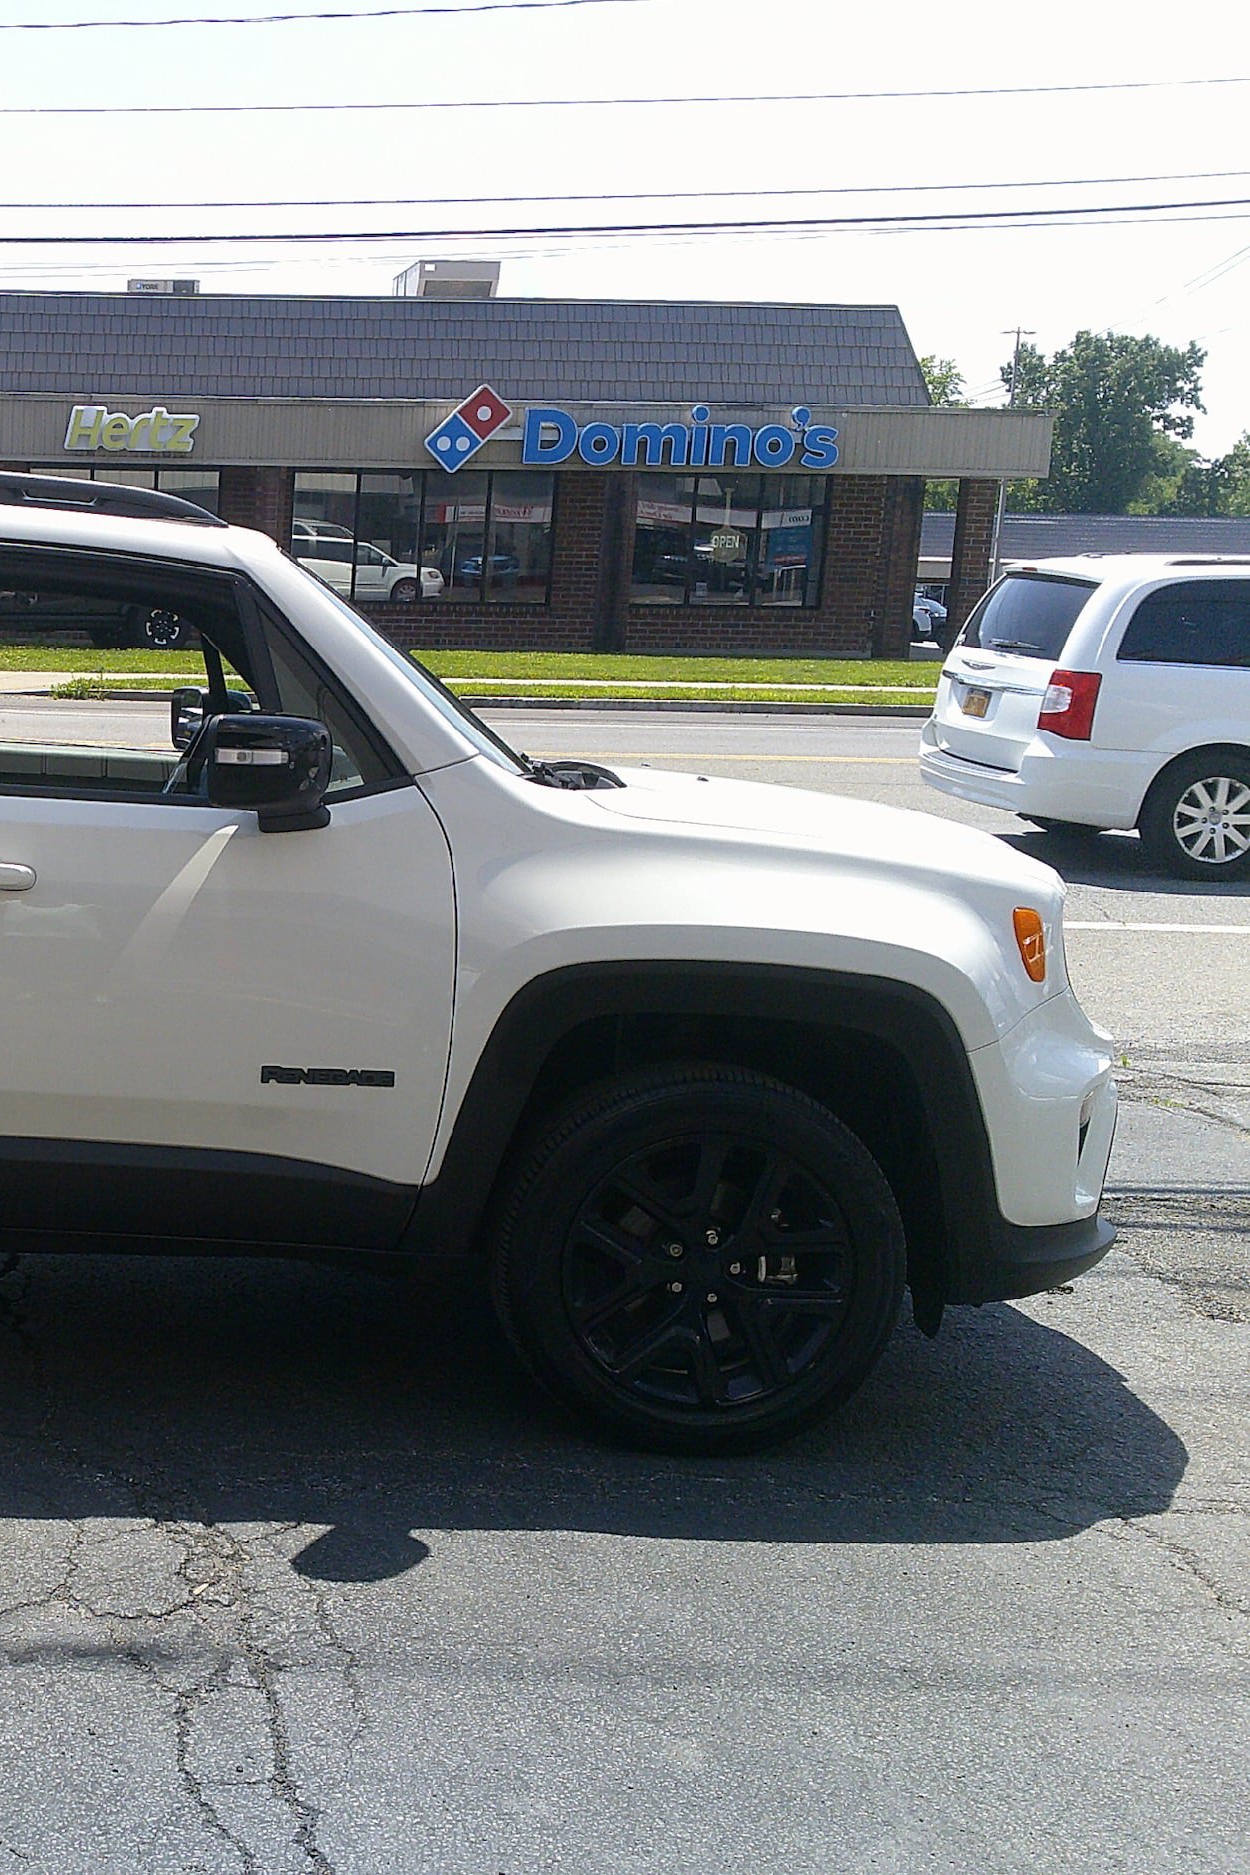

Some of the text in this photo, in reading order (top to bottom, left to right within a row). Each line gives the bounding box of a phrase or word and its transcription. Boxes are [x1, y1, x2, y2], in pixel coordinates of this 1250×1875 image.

[66, 405, 200, 452] Hertz
[522, 404, 840, 469] Domino's
[710, 534, 741, 549] OPEN
